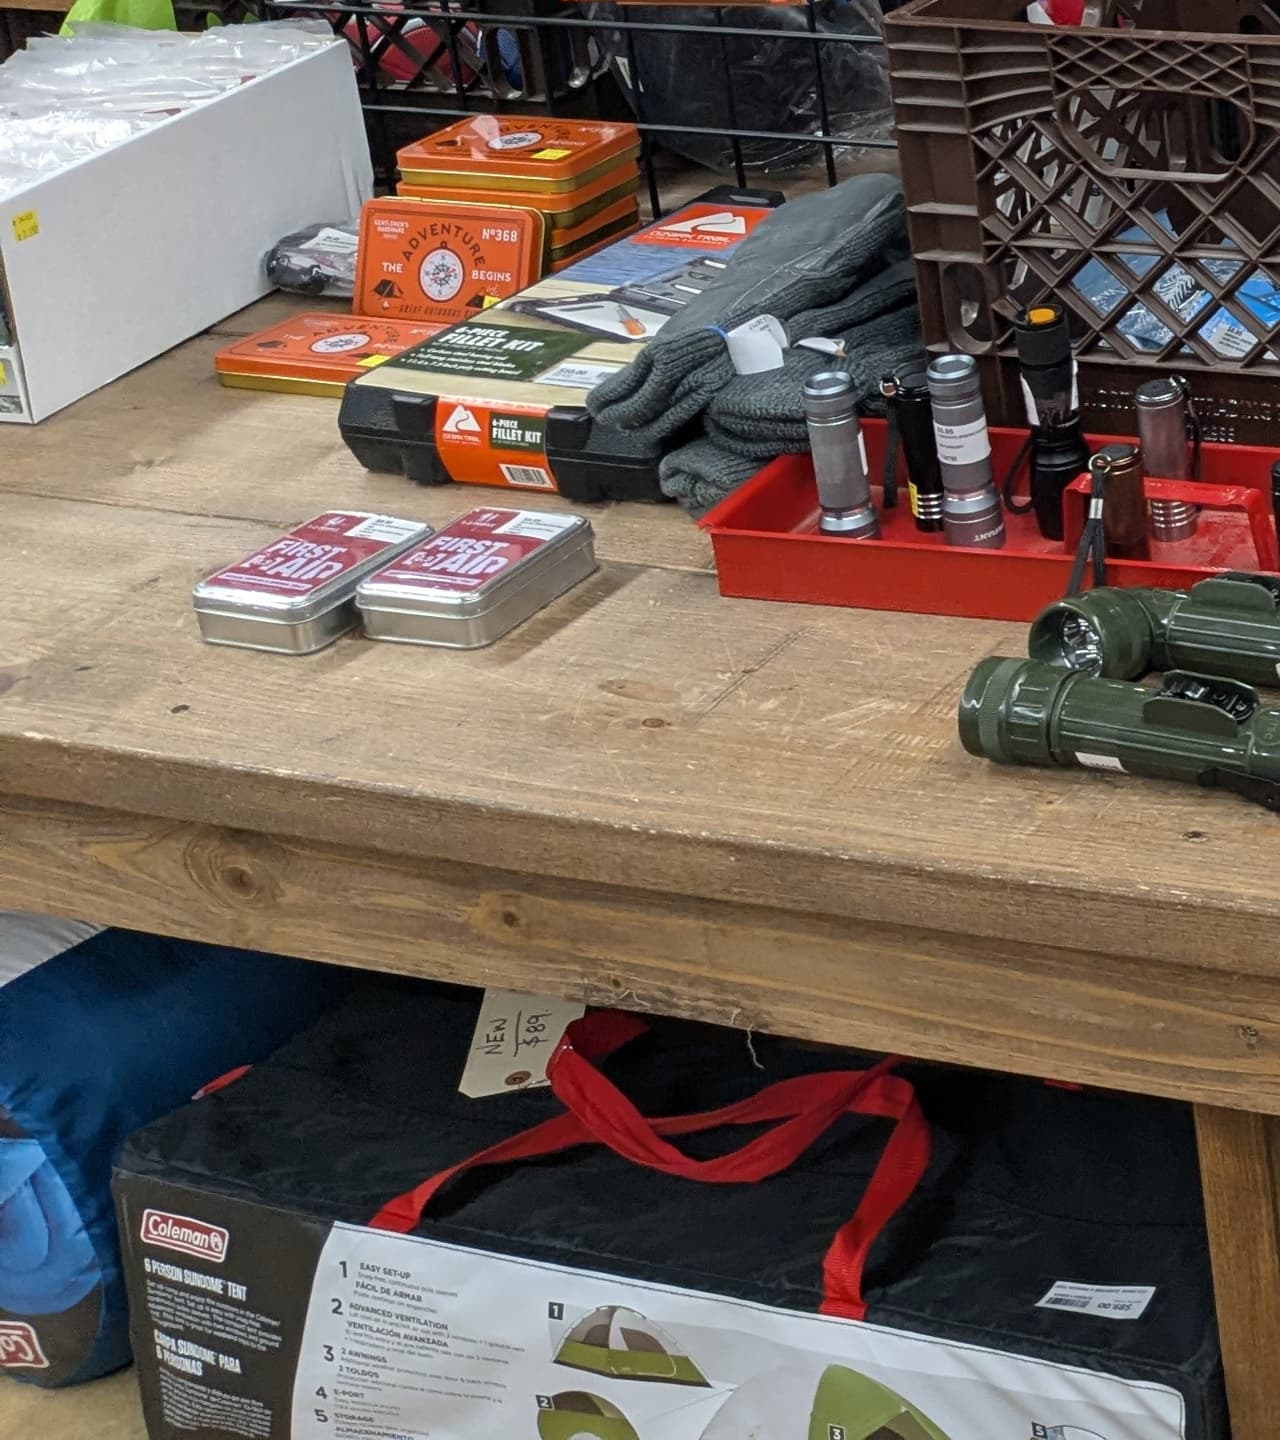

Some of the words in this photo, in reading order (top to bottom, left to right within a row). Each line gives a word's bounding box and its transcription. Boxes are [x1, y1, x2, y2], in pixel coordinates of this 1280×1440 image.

[402, 223, 486, 267] ADVENTURE
[381, 261, 403, 273] THE
[471, 269, 513, 283] BEGINS
[491, 418, 519, 429] 6-PIECE
[491, 427, 522, 442] FILLET
[525, 430, 543, 444] KIT
[264, 539, 348, 559] FIRST
[424, 535, 510, 556] FIRST
[476, 1017, 507, 1056] NEW
[147, 1215, 210, 1250] Coleman
[348, 1301, 394, 1320] ADVANCED
[395, 1310, 450, 1331] VENTILATION
